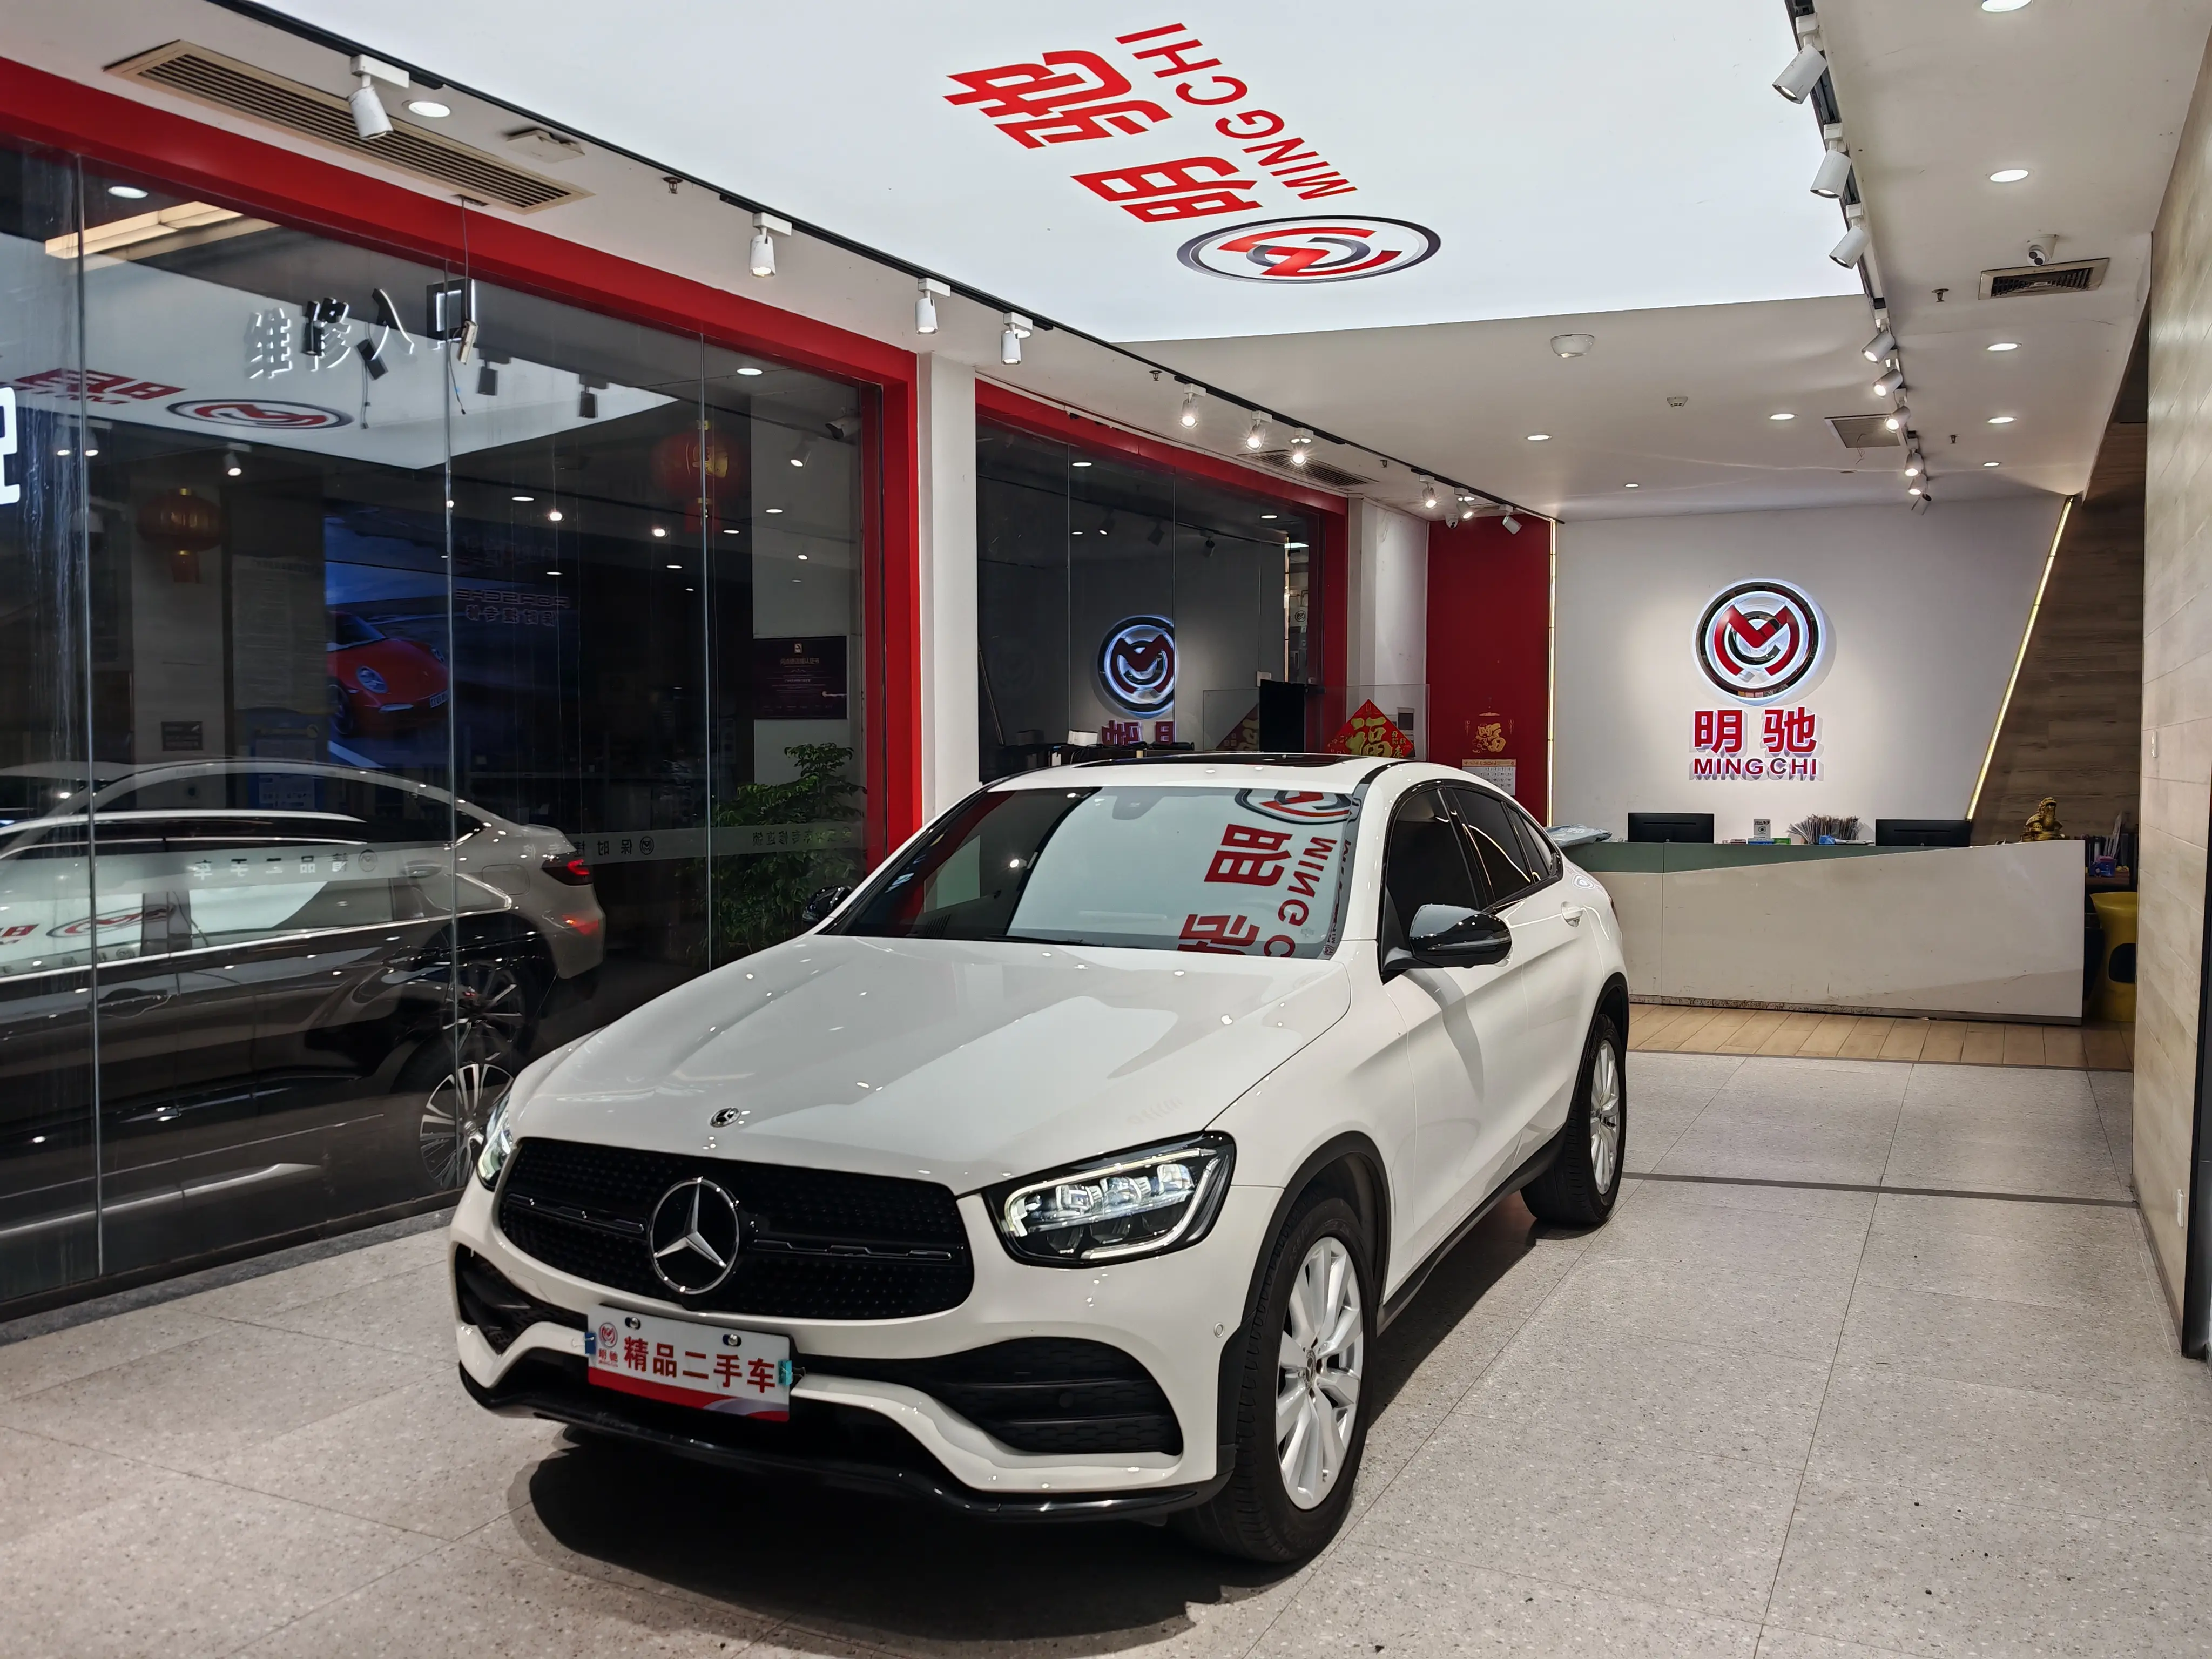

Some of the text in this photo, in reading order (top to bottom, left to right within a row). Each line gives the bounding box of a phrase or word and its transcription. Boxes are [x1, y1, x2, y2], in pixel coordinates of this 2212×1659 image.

[942, 50, 1263, 223] 明驰
[244, 278, 476, 379] 维修入口
[1694, 706, 1817, 753] 明驰
[624, 1335, 776, 1393] 精品二手车
